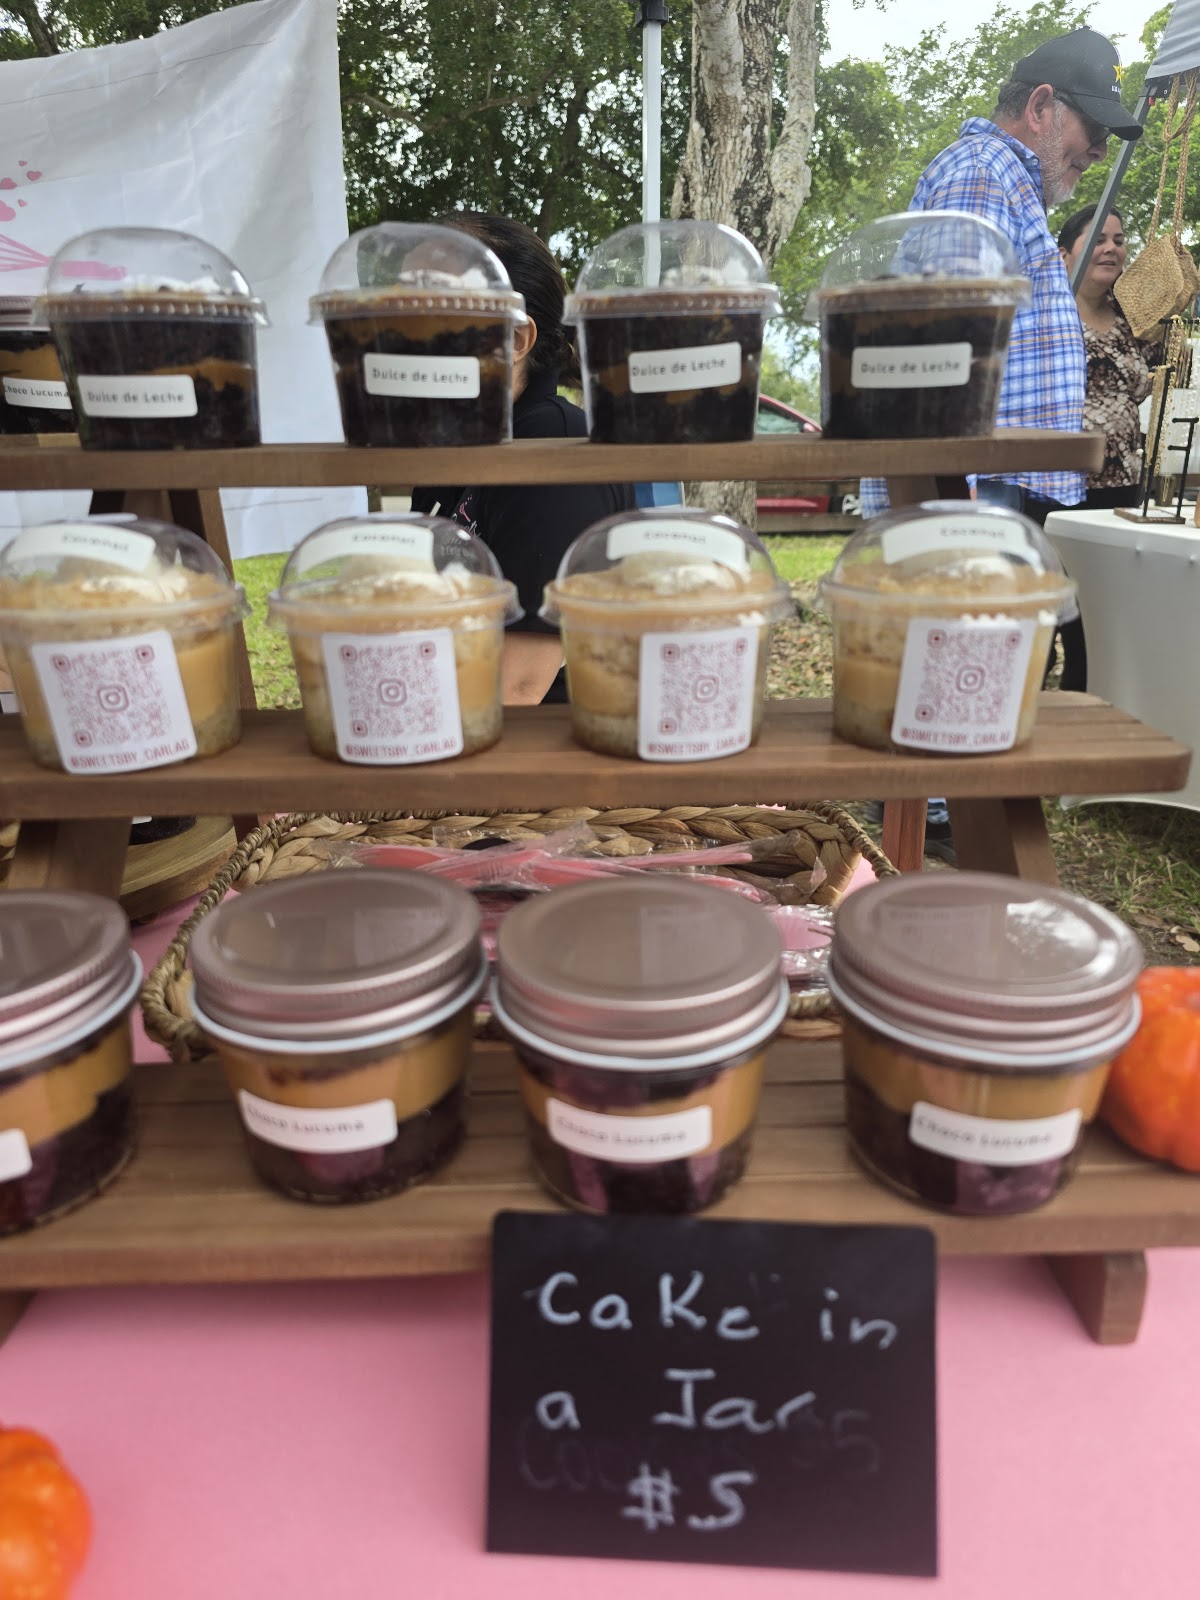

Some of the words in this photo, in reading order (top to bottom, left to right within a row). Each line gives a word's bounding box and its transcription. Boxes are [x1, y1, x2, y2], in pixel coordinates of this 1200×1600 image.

[372, 367, 407, 381] Dulce
[413, 370, 429, 383] de
[433, 371, 469, 384] Leche
[632, 364, 666, 377] Dulce
[671, 361, 687, 374] de
[691, 358, 726, 372] Leche
[901, 361, 917, 374] de
[124, 391, 138, 404] de
[819, 1286, 898, 1350] in
[535, 1390, 582, 1431] a
[651, 1368, 817, 1434] Jar
